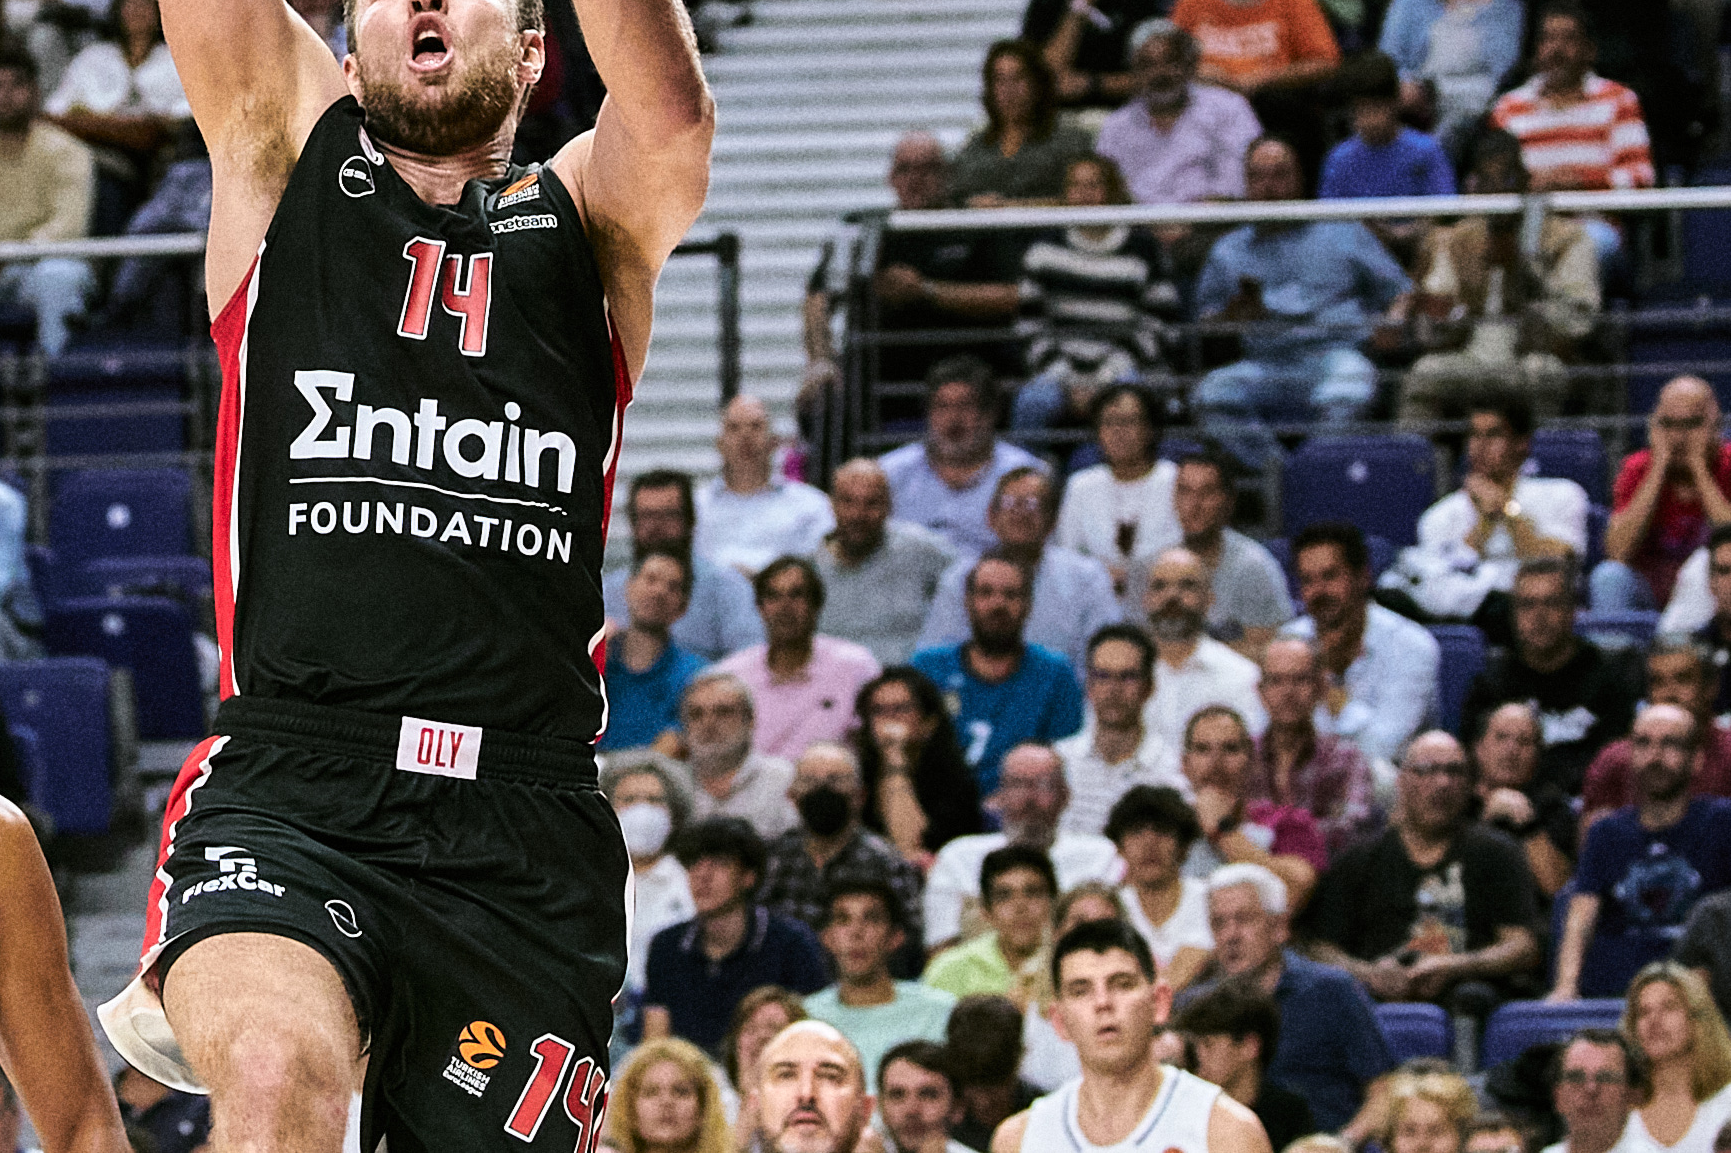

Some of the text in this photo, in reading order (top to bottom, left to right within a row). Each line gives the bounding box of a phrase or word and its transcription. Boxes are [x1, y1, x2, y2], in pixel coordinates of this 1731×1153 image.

[397, 236, 494, 357] 14
[288, 500, 572, 563] FOUNDATION
[417, 727, 464, 769] OLY
[181, 871, 286, 905] FlexCar
[445, 1063, 486, 1091] AIRLINES
[451, 1055, 491, 1085] TURKISH
[504, 1033, 605, 1153] 14
